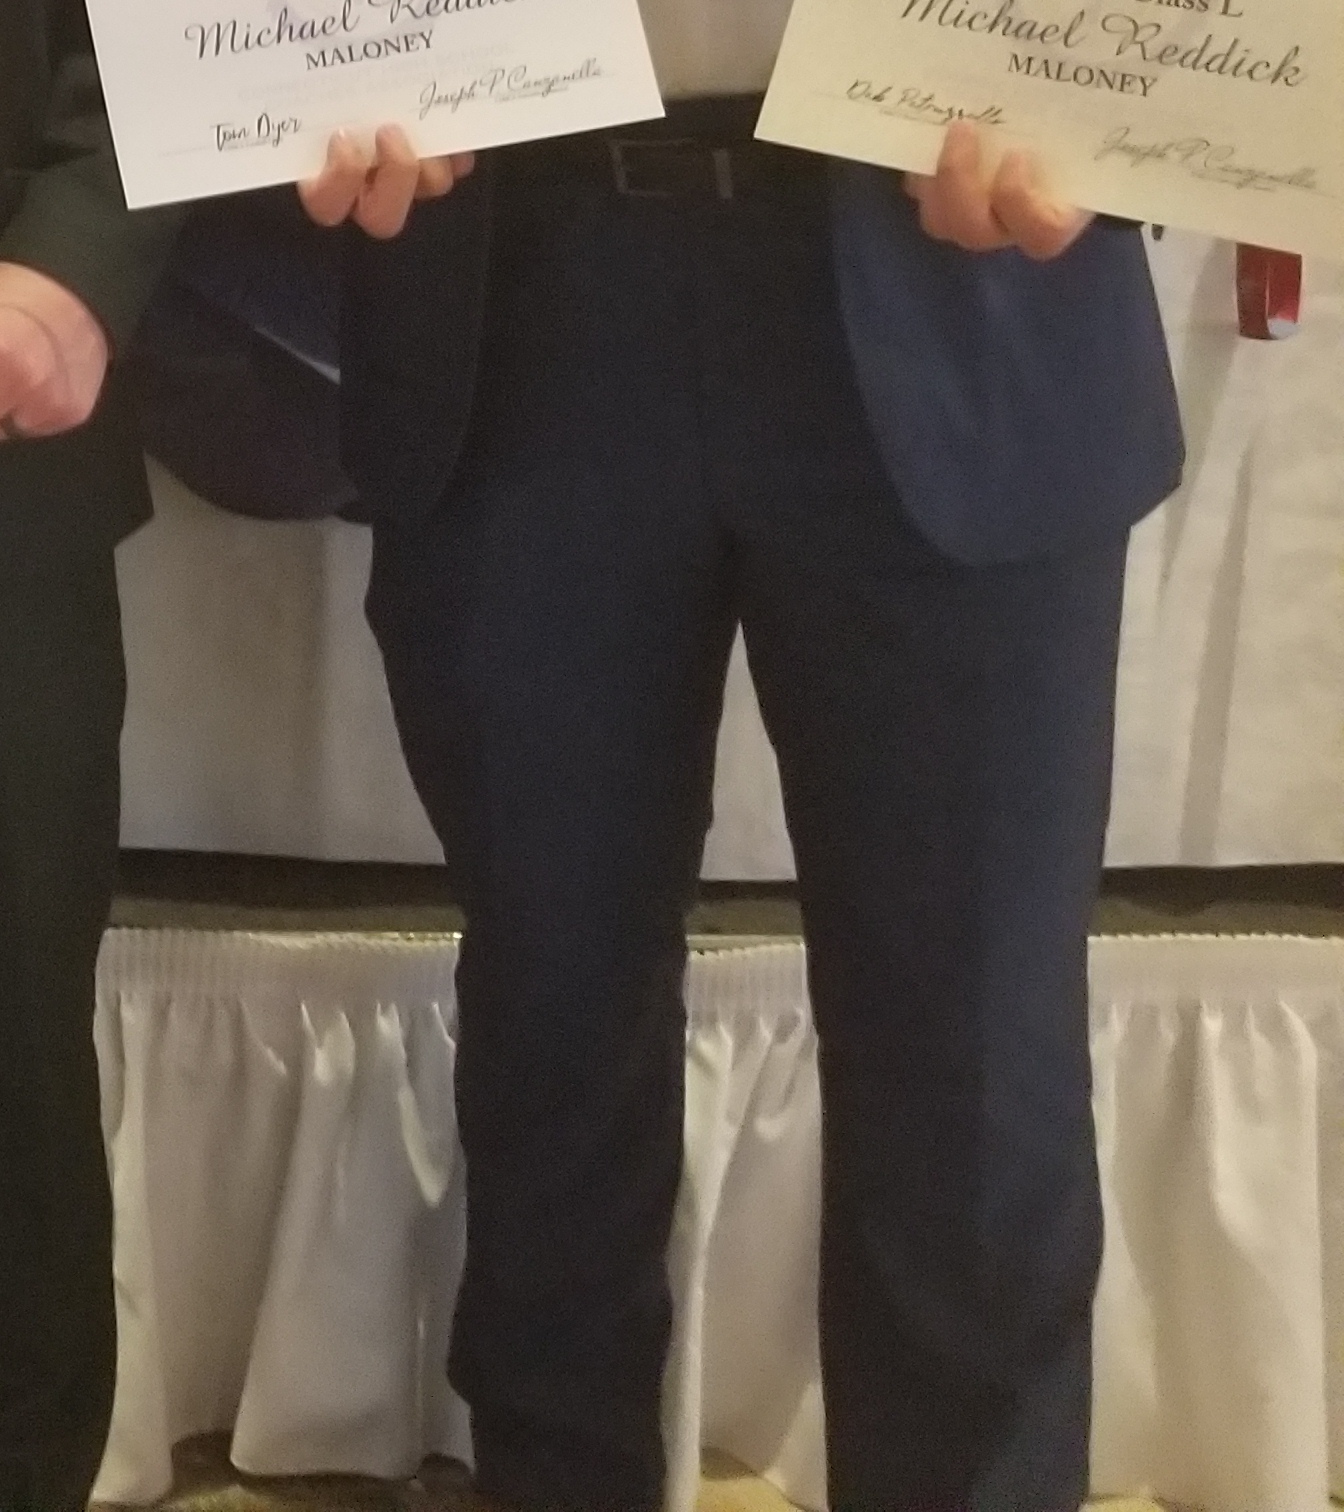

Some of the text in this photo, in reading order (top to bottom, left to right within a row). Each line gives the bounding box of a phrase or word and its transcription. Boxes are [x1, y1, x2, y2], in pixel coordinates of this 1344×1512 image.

[305, 29, 434, 72] MALONEY
[1100, 13, 1306, 87] Reddick
[1008, 53, 1157, 98] MALONEY
